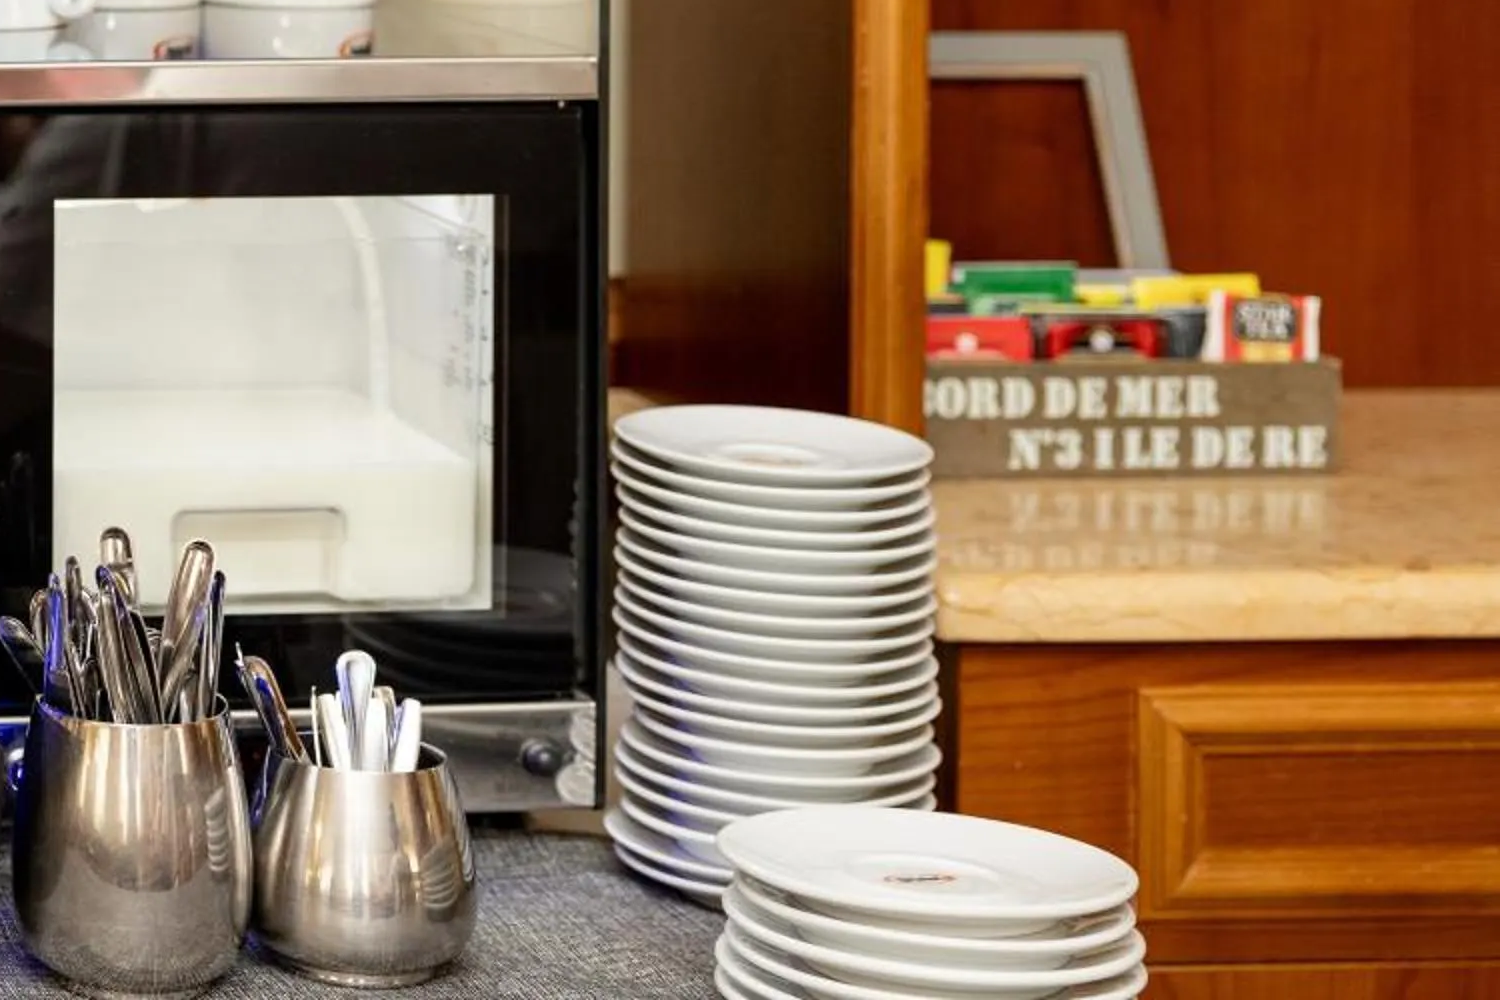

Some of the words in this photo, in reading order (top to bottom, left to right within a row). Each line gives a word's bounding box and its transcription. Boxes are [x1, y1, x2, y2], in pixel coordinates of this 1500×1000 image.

[1043, 376, 1108, 418] DE
[1116, 375, 1220, 417] MER
[1192, 426, 1255, 468] DE
